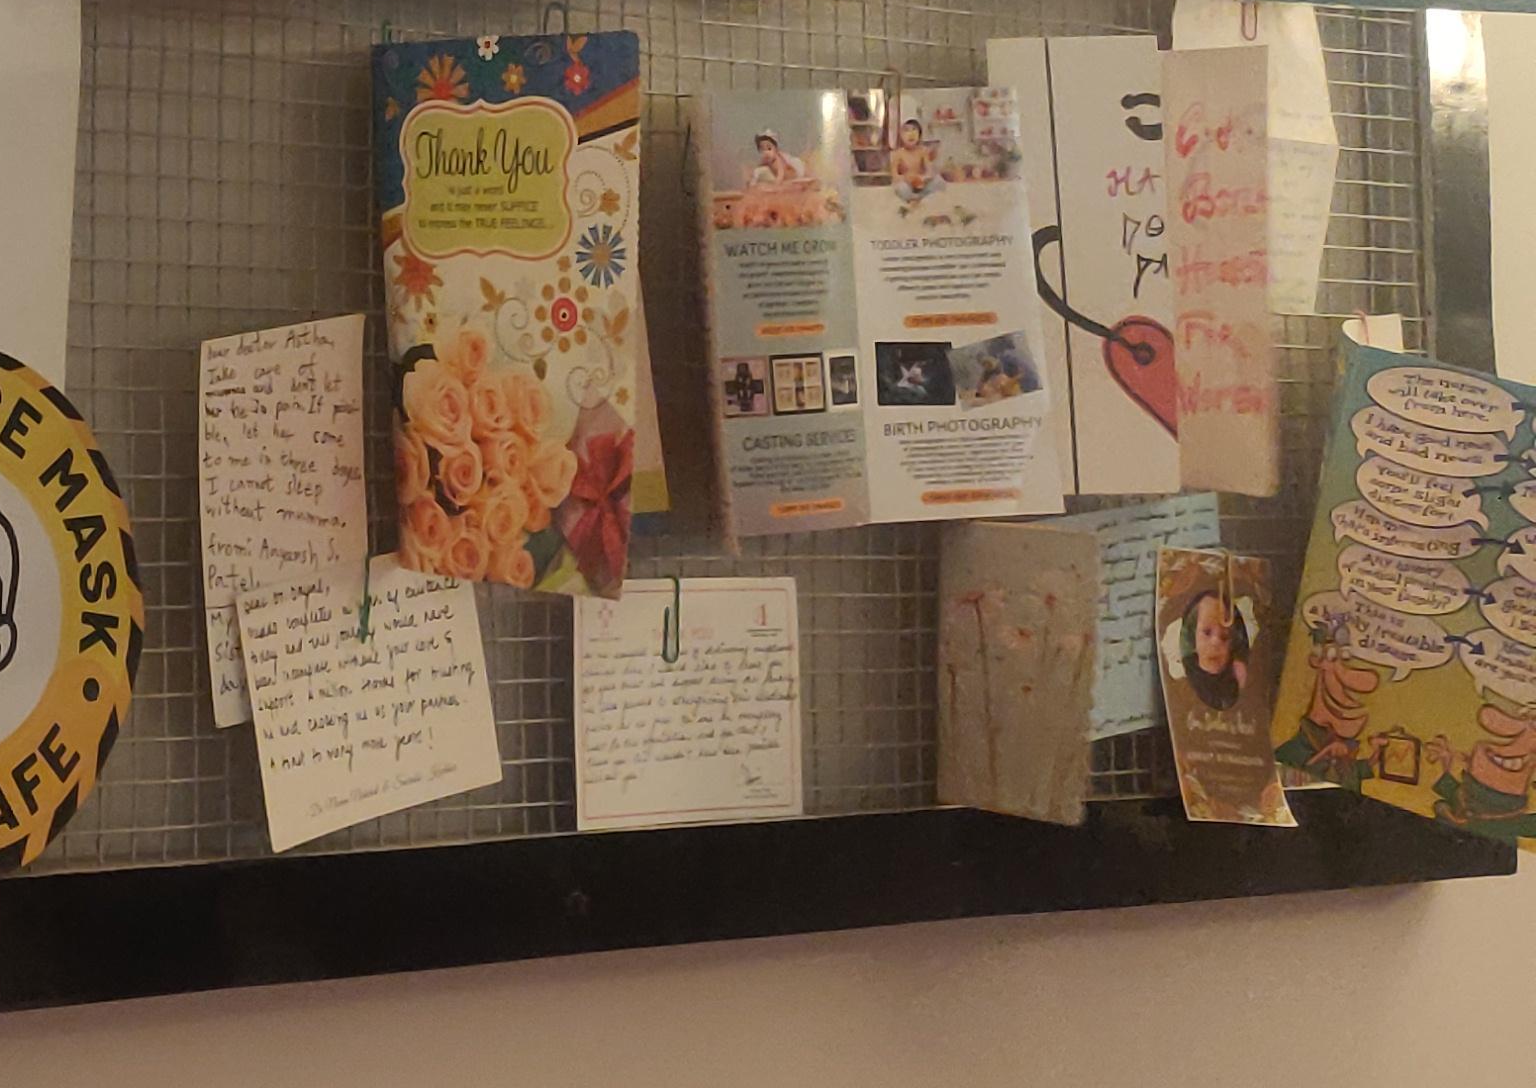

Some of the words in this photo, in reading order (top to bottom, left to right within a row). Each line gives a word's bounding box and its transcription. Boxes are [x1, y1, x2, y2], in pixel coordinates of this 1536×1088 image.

[416, 128, 491, 179] Thank
[494, 129, 554, 193] You
[725, 241, 777, 257] WATCH
[884, 422, 923, 436] BIRTH
[929, 417, 1042, 433] PHOTOGRAPHY
[742, 434, 802, 450] CASTING
[52, 450, 119, 655] MASK
